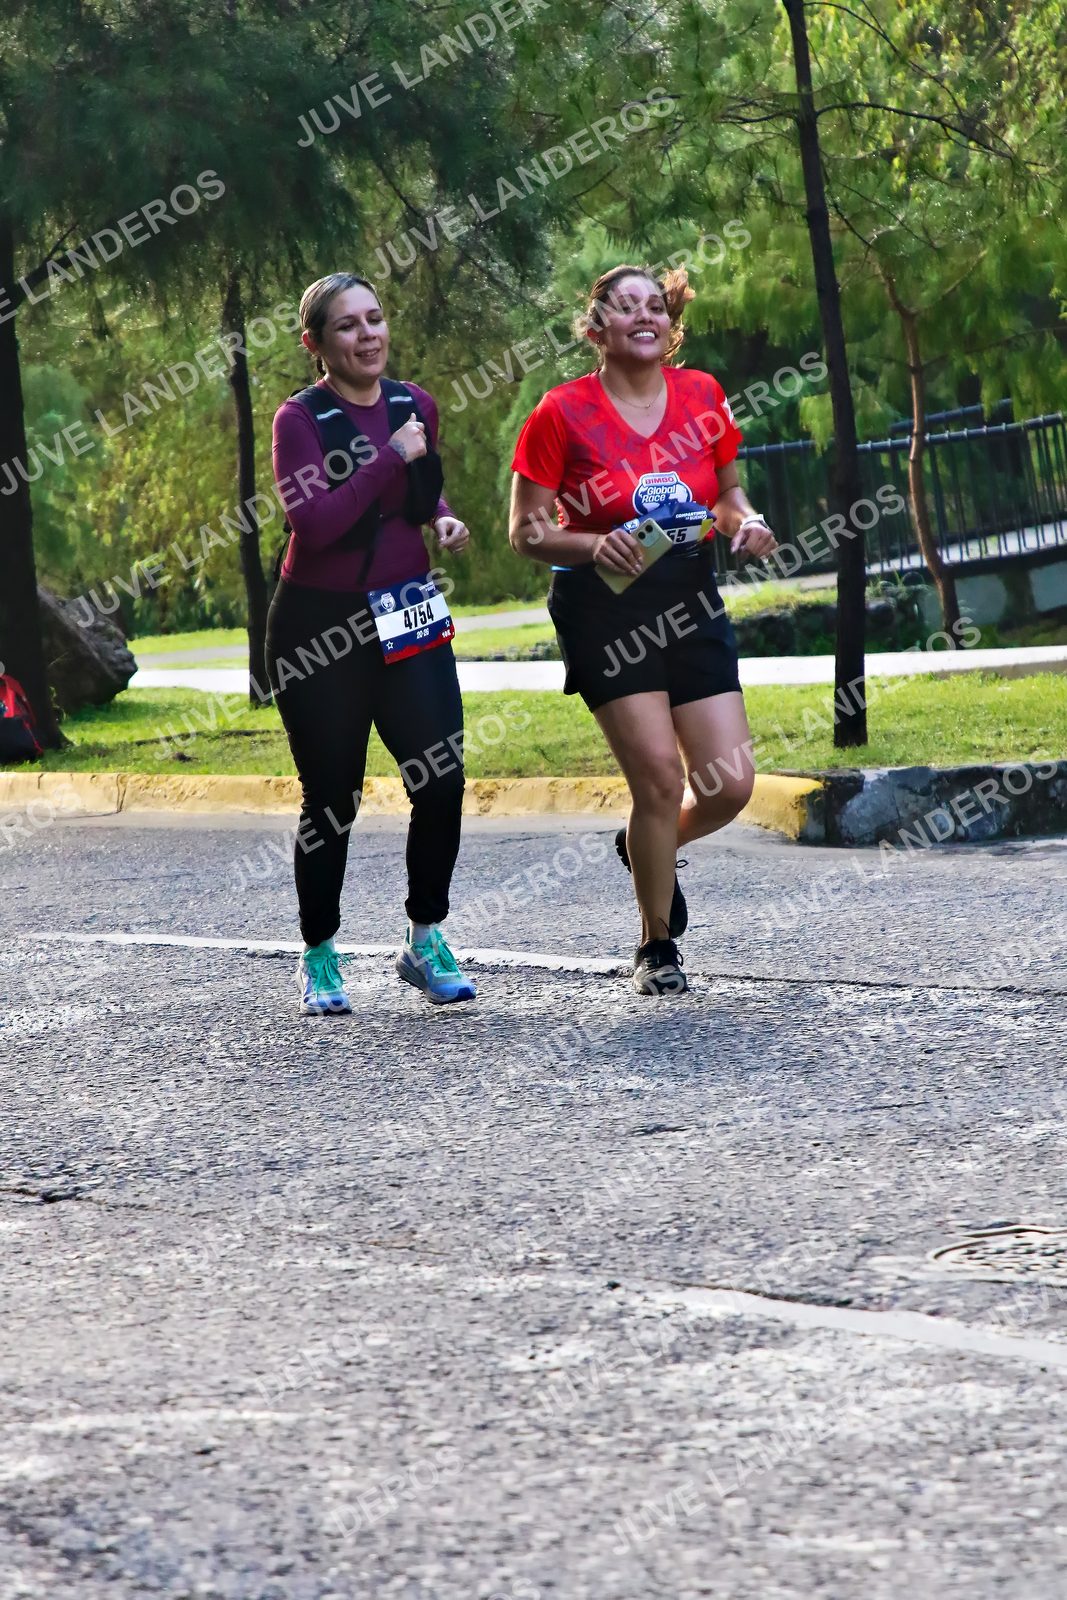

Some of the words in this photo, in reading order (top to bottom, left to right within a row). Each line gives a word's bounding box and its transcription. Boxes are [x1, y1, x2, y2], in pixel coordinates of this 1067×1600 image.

[645, 477, 674, 485] BIMBO
[647, 485, 676, 495] Global
[641, 494, 666, 503] Race
[403, 601, 434, 630] 4754
